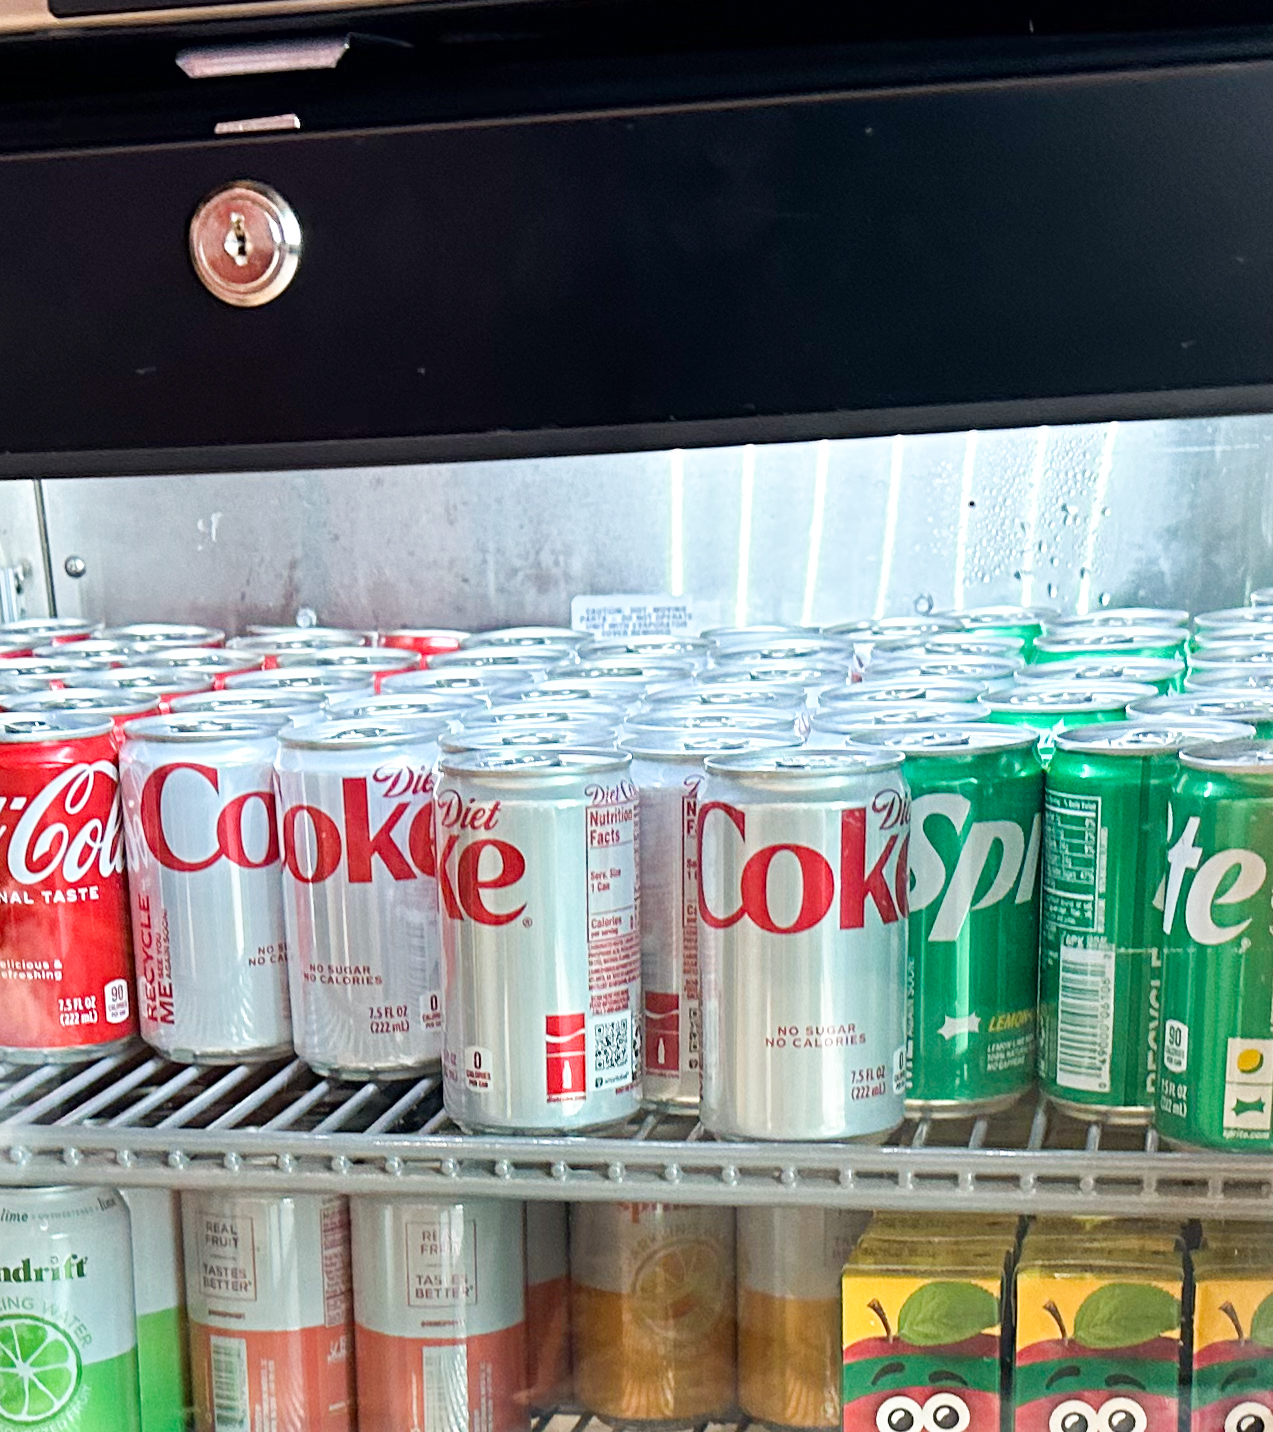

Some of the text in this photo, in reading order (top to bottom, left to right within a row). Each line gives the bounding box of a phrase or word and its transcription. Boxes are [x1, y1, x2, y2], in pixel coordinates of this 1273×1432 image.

[584, 783, 620, 805] Diet
[141, 762, 279, 873] Co
[437, 789, 502, 831] Diet
[589, 808, 633, 827] Nutrition
[589, 830, 621, 846] Facts
[41, 886, 99, 903] TASTE
[597, 881, 610, 892] Can
[590, 914, 622, 930] Calories
[258, 944, 274, 956] NO
[53, 959, 62, 969] &
[138, 894, 159, 1023] RECYCLE
[249, 956, 265, 967] NO
[309, 963, 370, 975] NO SUGAR
[304, 972, 383, 985] NO CALORIES
[111, 984, 124, 1002] 90
[73, 997, 83, 1011] FL
[84, 995, 96, 1010] OZ
[158, 981, 176, 1025] ME
[429, 994, 439, 1012] 0
[59, 1012, 80, 1027] (222
[369, 1005, 408, 1020] 7.5 FL OZ
[370, 1021, 390, 1034] (222
[392, 1019, 410, 1033] mL)
[777, 1023, 857, 1037] NO SUGAR
[765, 1033, 866, 1048] NO CALORIES
[1169, 1026, 1182, 1047] 90
[473, 1051, 482, 1069] 0
[851, 1065, 886, 1085] 7.5 FL OZ
[851, 1082, 887, 1101] (222 mL)
[1177, 1083, 1188, 1099] OZ
[0, 1207, 29, 1223] lime
[206, 1221, 238, 1235] REAL
[205, 1233, 239, 1249] FRUIT
[203, 1262, 247, 1279] TASTES
[42, 1298, 93, 1348] WATER
